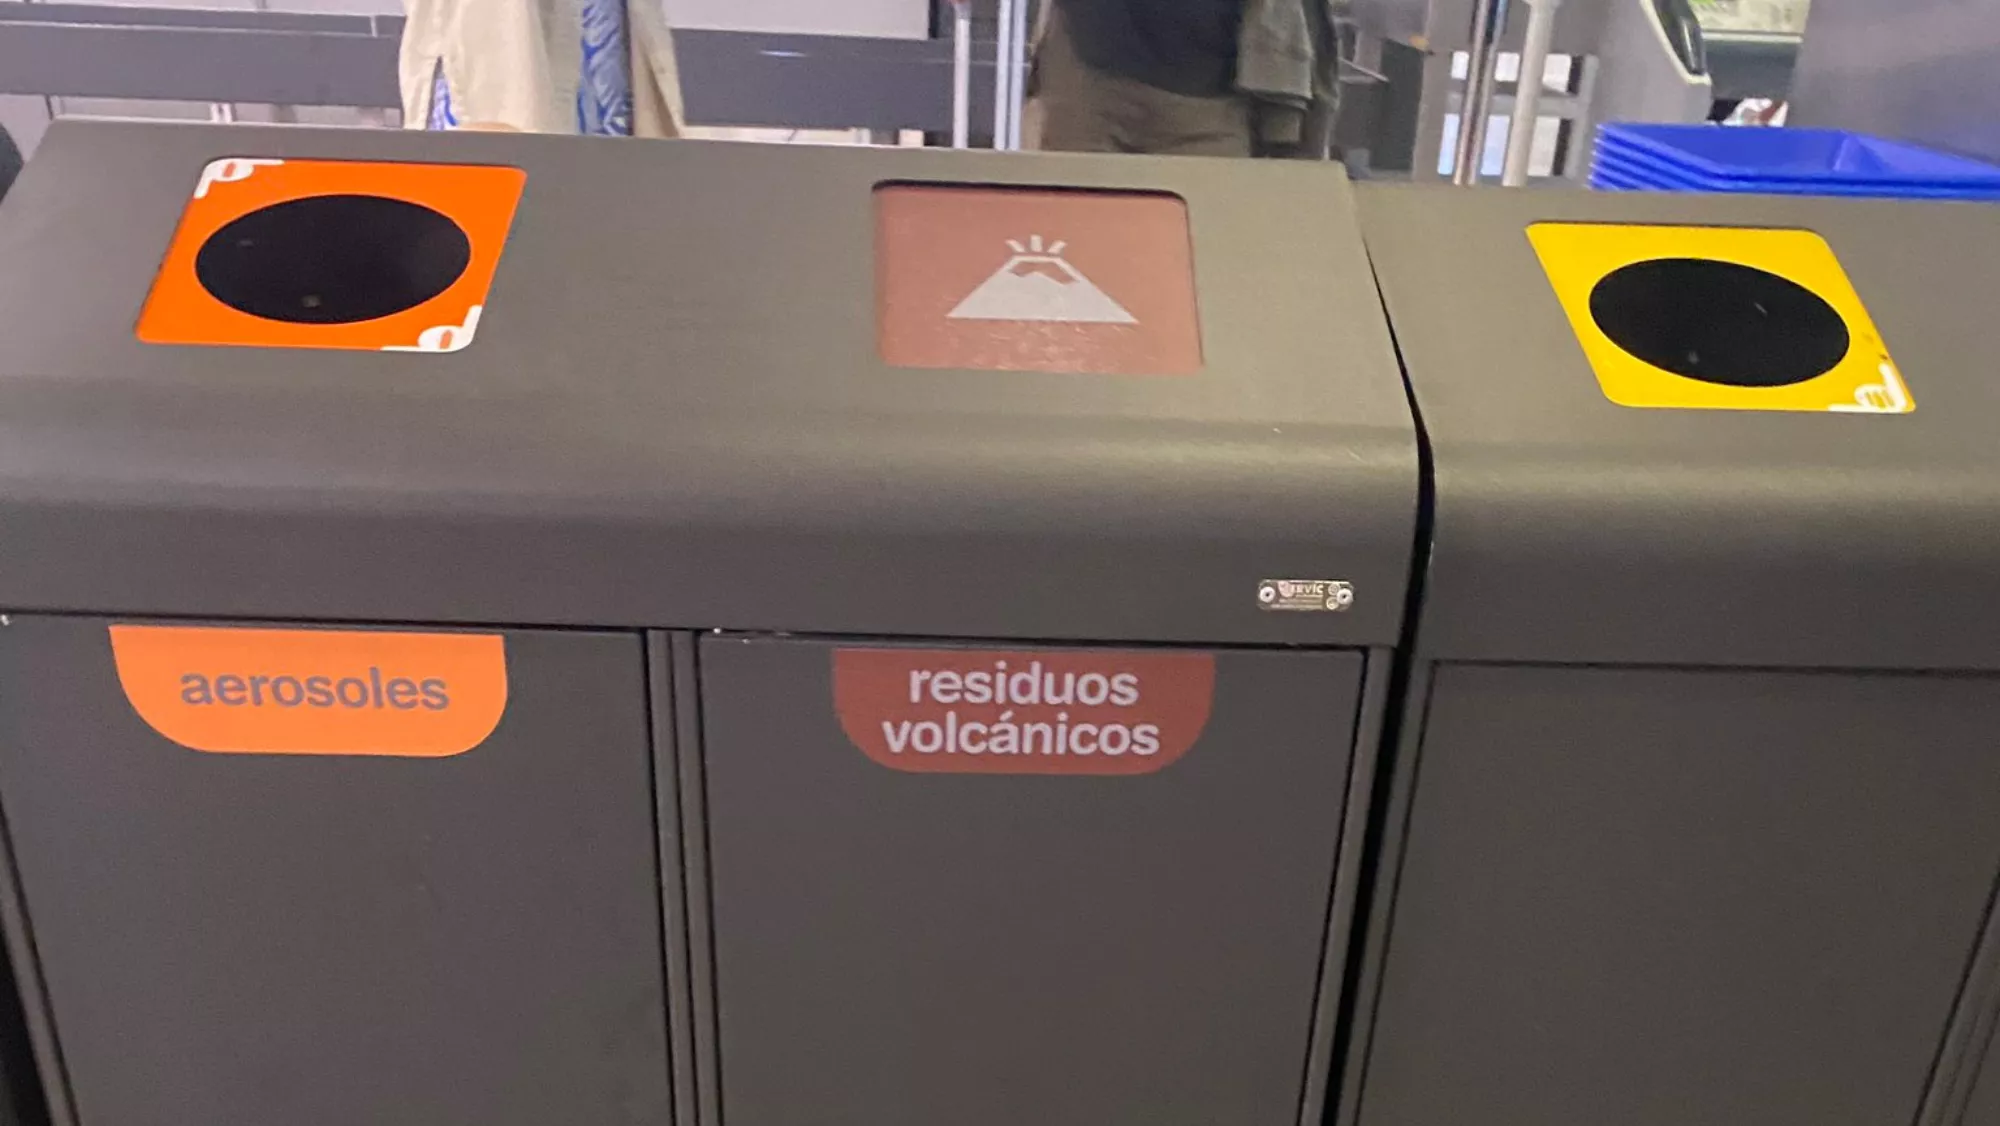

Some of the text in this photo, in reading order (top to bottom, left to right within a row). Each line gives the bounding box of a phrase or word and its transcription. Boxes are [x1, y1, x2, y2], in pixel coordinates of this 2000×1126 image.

[180, 665, 450, 711] aerosoles
[909, 660, 1139, 706] residuos
[881, 709, 1160, 756] volcánicos
